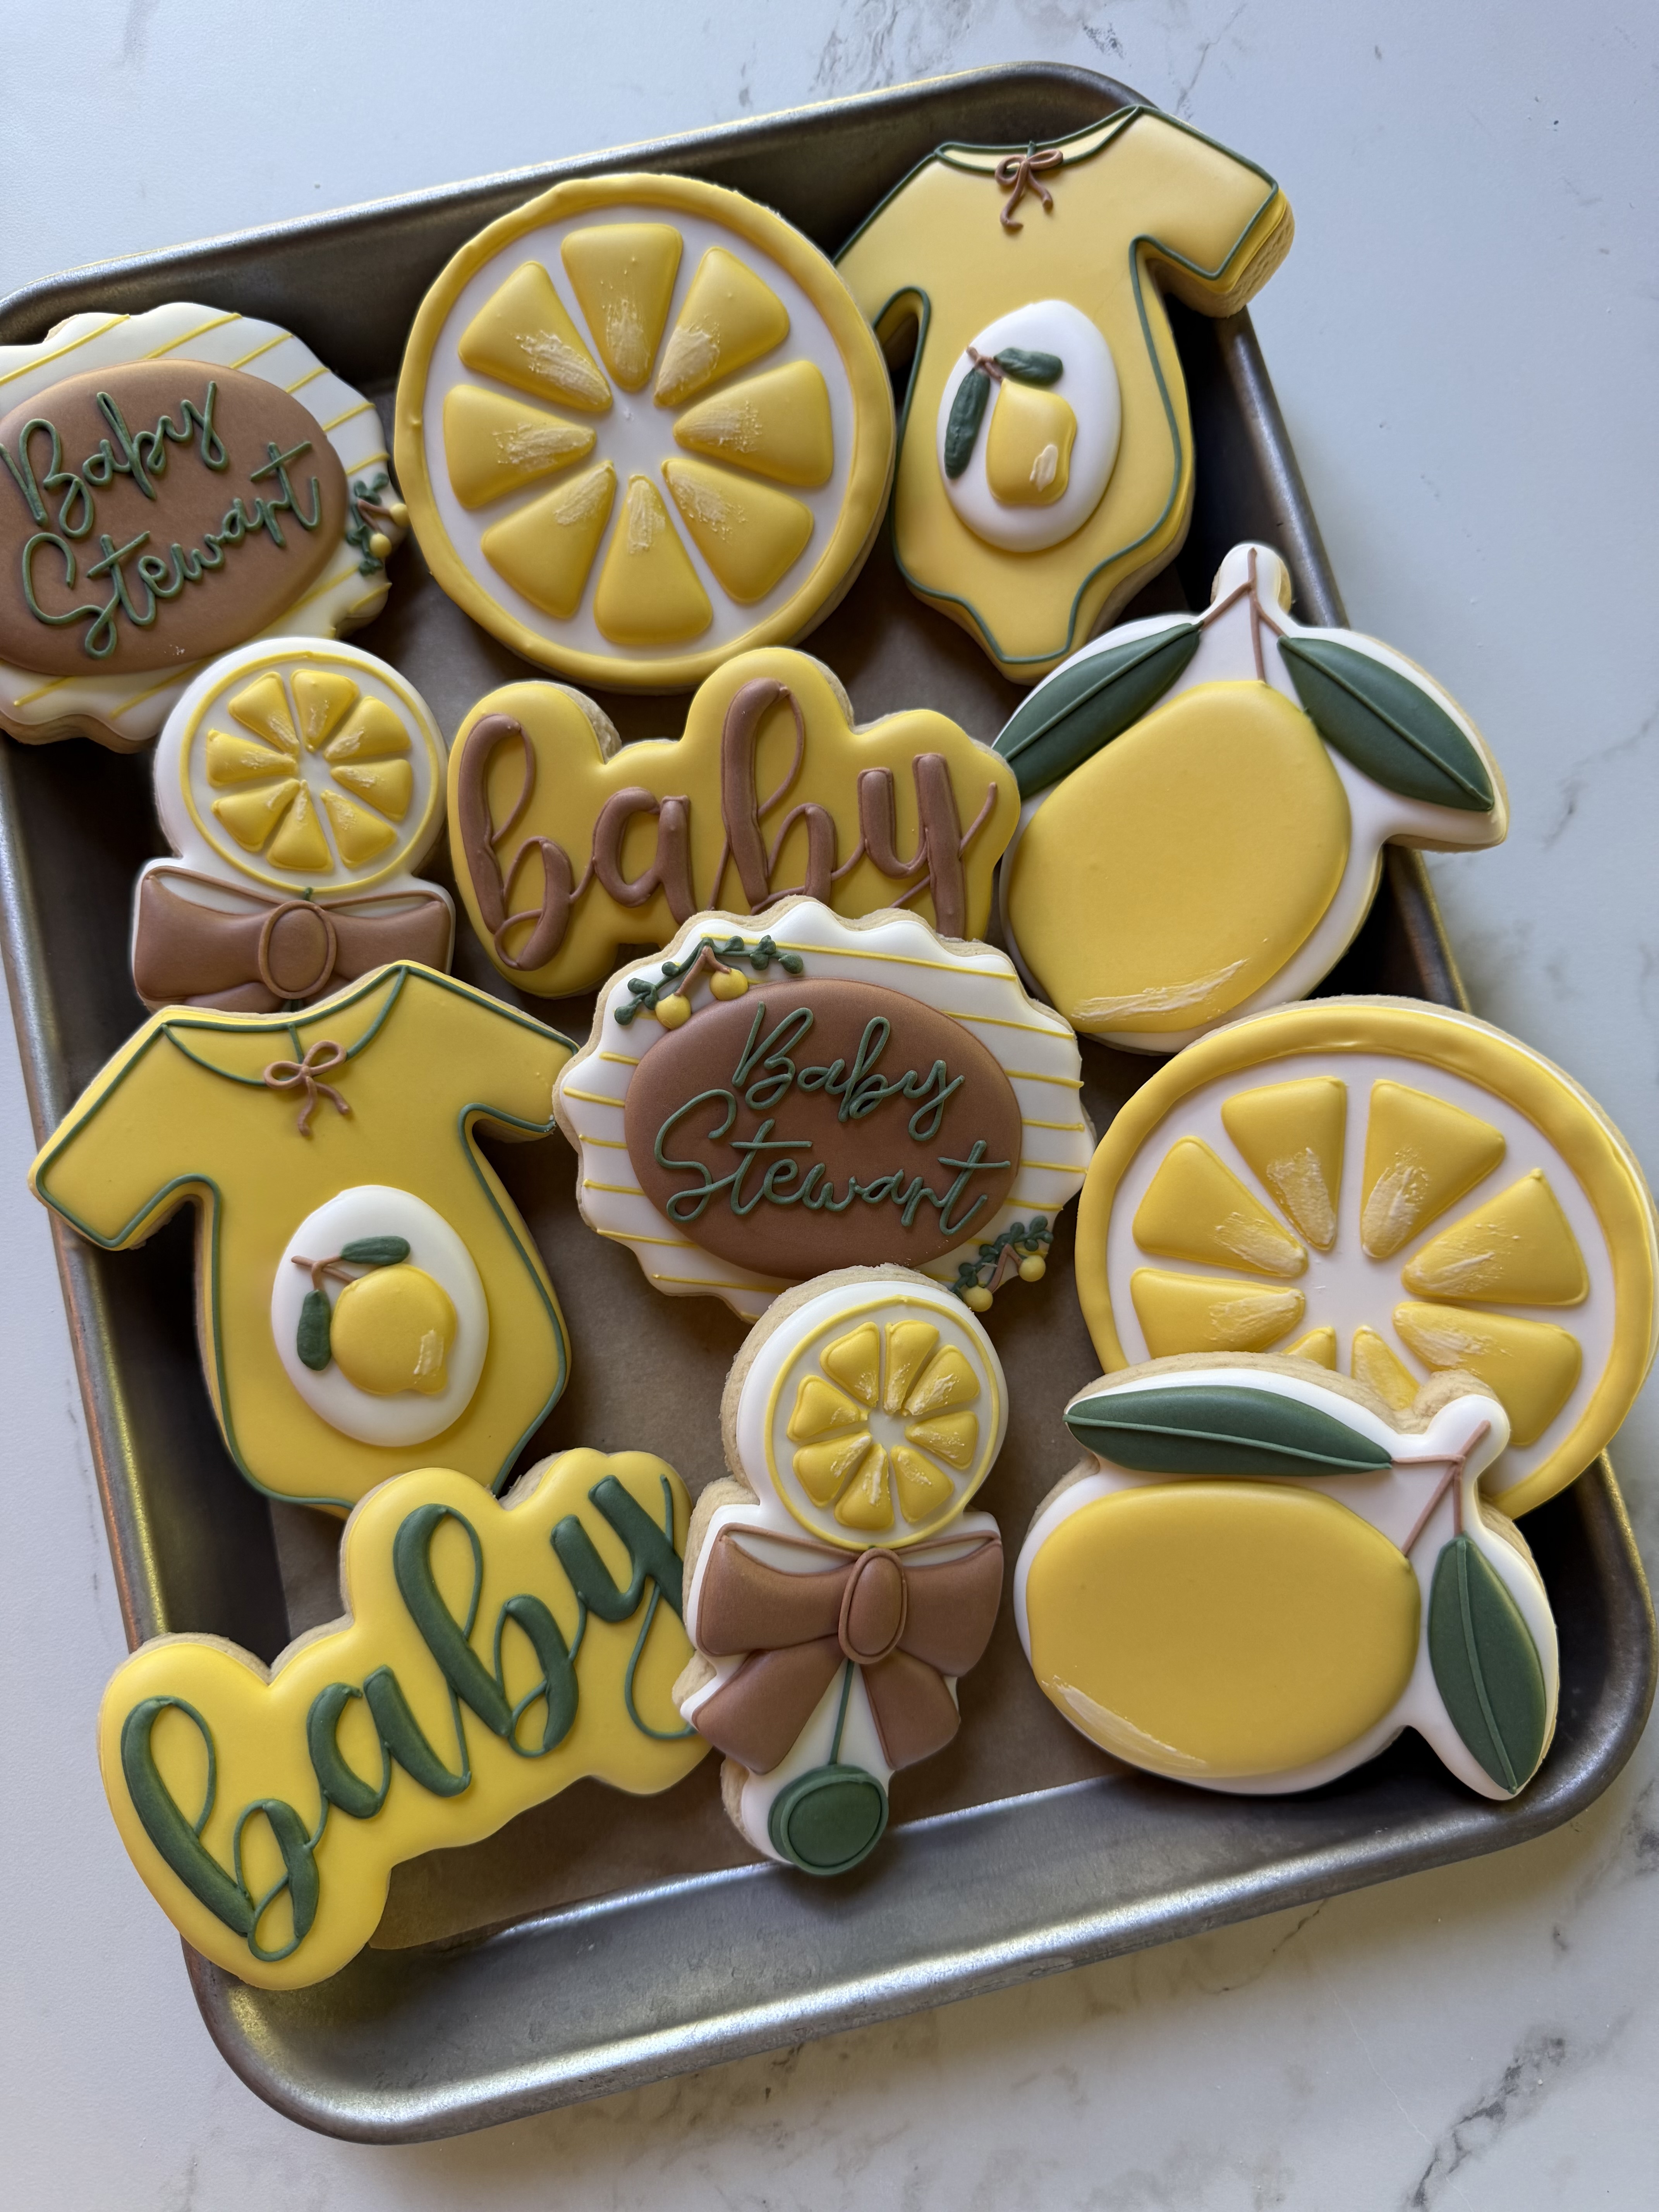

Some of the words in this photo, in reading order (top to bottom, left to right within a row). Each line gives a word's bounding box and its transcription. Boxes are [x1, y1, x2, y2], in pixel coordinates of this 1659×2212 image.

[0, 381, 228, 538] Baby
[22, 441, 320, 659] Stewart
[458, 678, 998, 972] baby
[654, 1089, 1011, 1235] Stewart
[732, 1001, 965, 1142] Baby
[121, 1474, 699, 1962] baby
